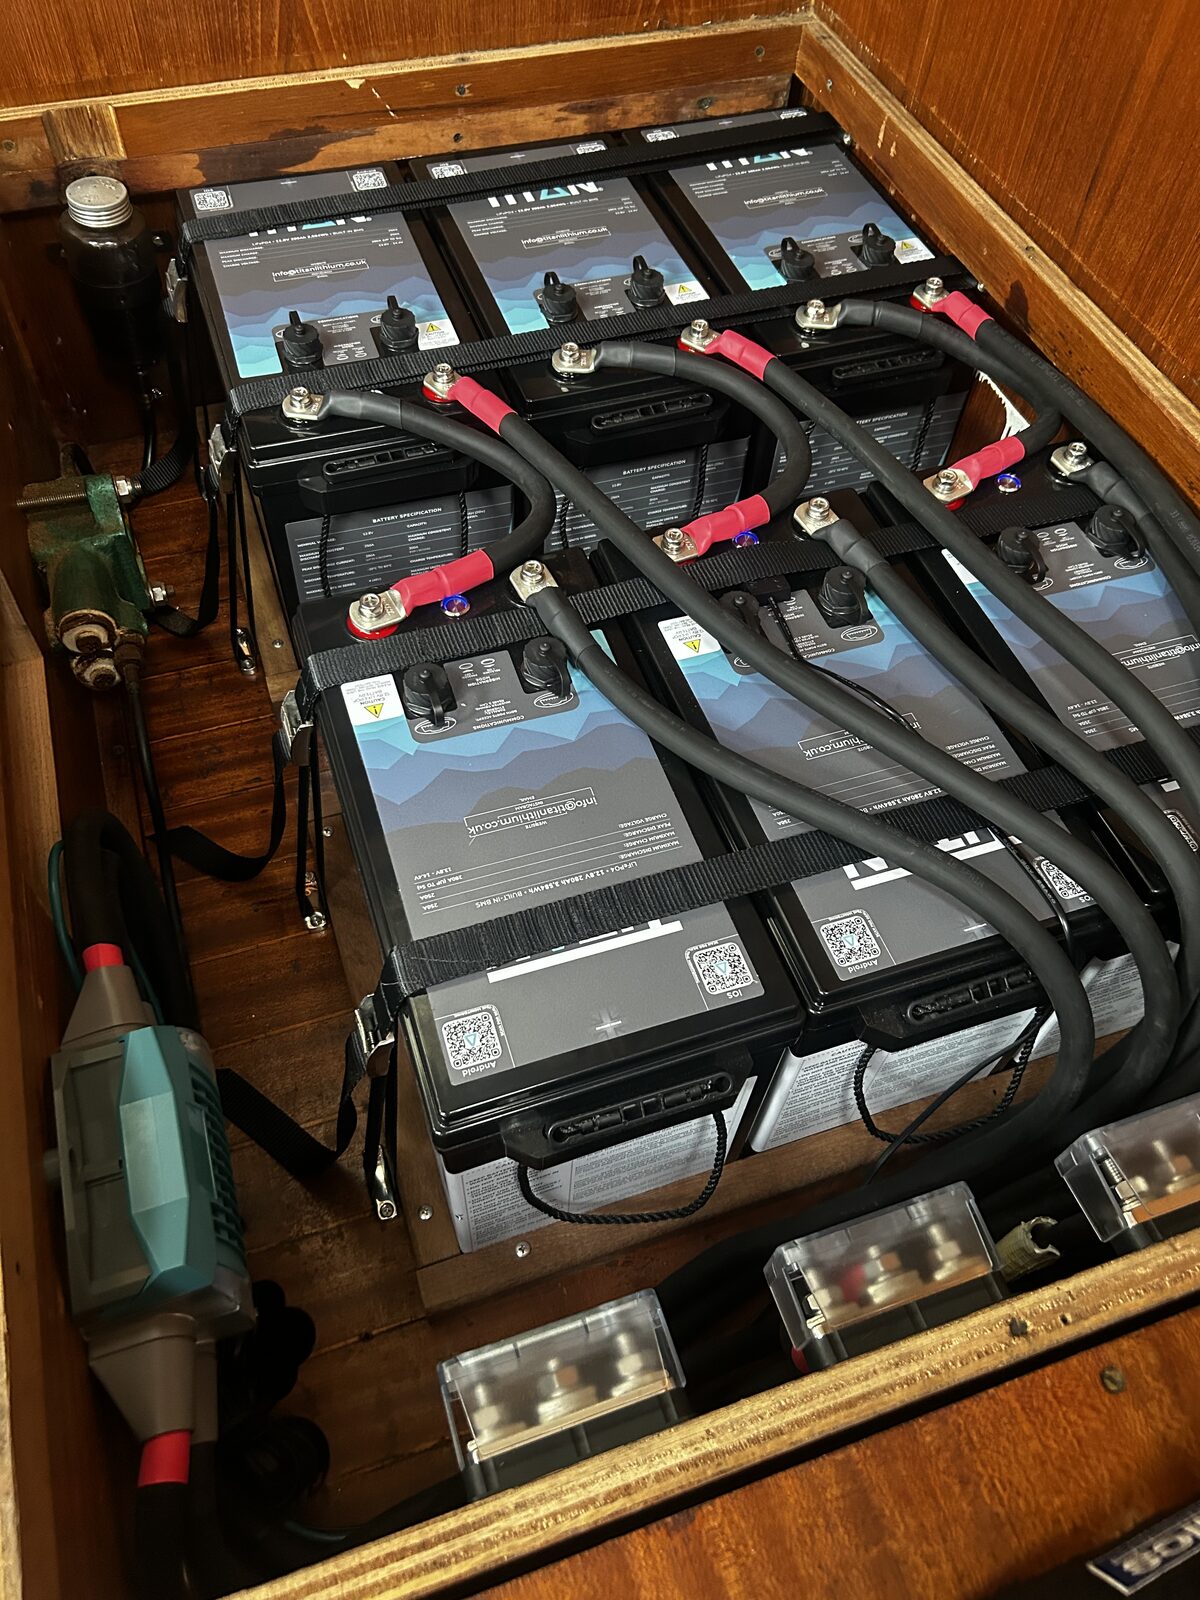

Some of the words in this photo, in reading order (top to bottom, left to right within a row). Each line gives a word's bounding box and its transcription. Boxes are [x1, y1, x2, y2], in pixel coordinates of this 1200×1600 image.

[622, 467, 646, 475] BATTERY
[647, 459, 685, 470] SPECIFICATION
[372, 514, 398, 523] BATTERY
[399, 507, 441, 518] SPECIFICATION
[1120, 638, 1200, 669] nfo@titanlithium.
[472, 714, 524, 730] COMMUNICATIONS
[466, 794, 597, 837] info@titanlithium.co.uk
[644, 812, 667, 822] CHARGE
[656, 821, 671, 829] PEAK
[648, 831, 675, 841] MAXIMUM
[651, 840, 679, 850] MAXIMUM
[609, 861, 637, 872] LiFePO4
[560, 874, 583, 885] 280Ah
[584, 869, 604, 879] 12.8V
[474, 898, 491, 908] BMS
[847, 959, 877, 973] Android
[461, 1060, 496, 1077] Android
